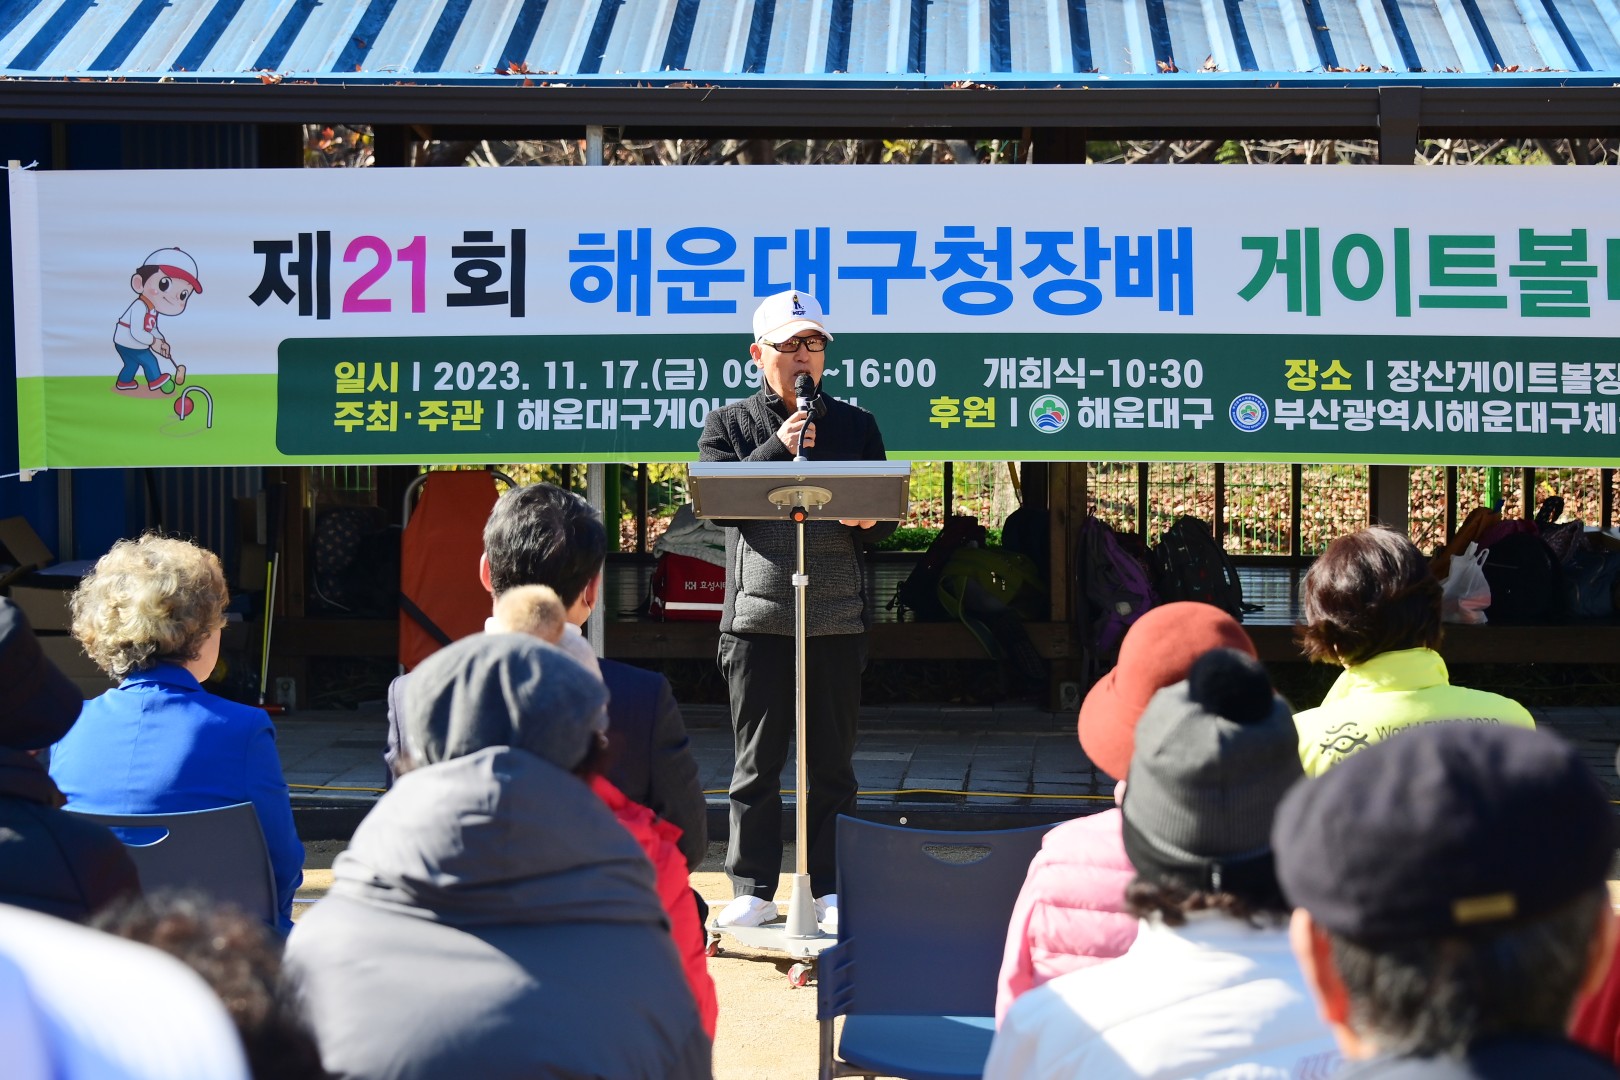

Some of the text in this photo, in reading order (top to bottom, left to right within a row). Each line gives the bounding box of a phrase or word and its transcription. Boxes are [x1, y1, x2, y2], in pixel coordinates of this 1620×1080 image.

[249, 226, 1620, 320] 제21회 해운대구청장배 게이트볼
[334, 361, 399, 394] 일시
[434, 361, 530, 391] 2023.
[544, 360, 587, 390] 11.
[601, 358, 709, 391] 17.(금)
[983, 357, 1203, 390] 개회식-10:30
[1284, 359, 1353, 392] 장소
[1387, 360, 1620, 395] 장산게이트볼장
[929, 396, 996, 429] 후원
[1077, 396, 1214, 430] 해운대구
[1273, 399, 1620, 435] 부산광역시해운대구체
